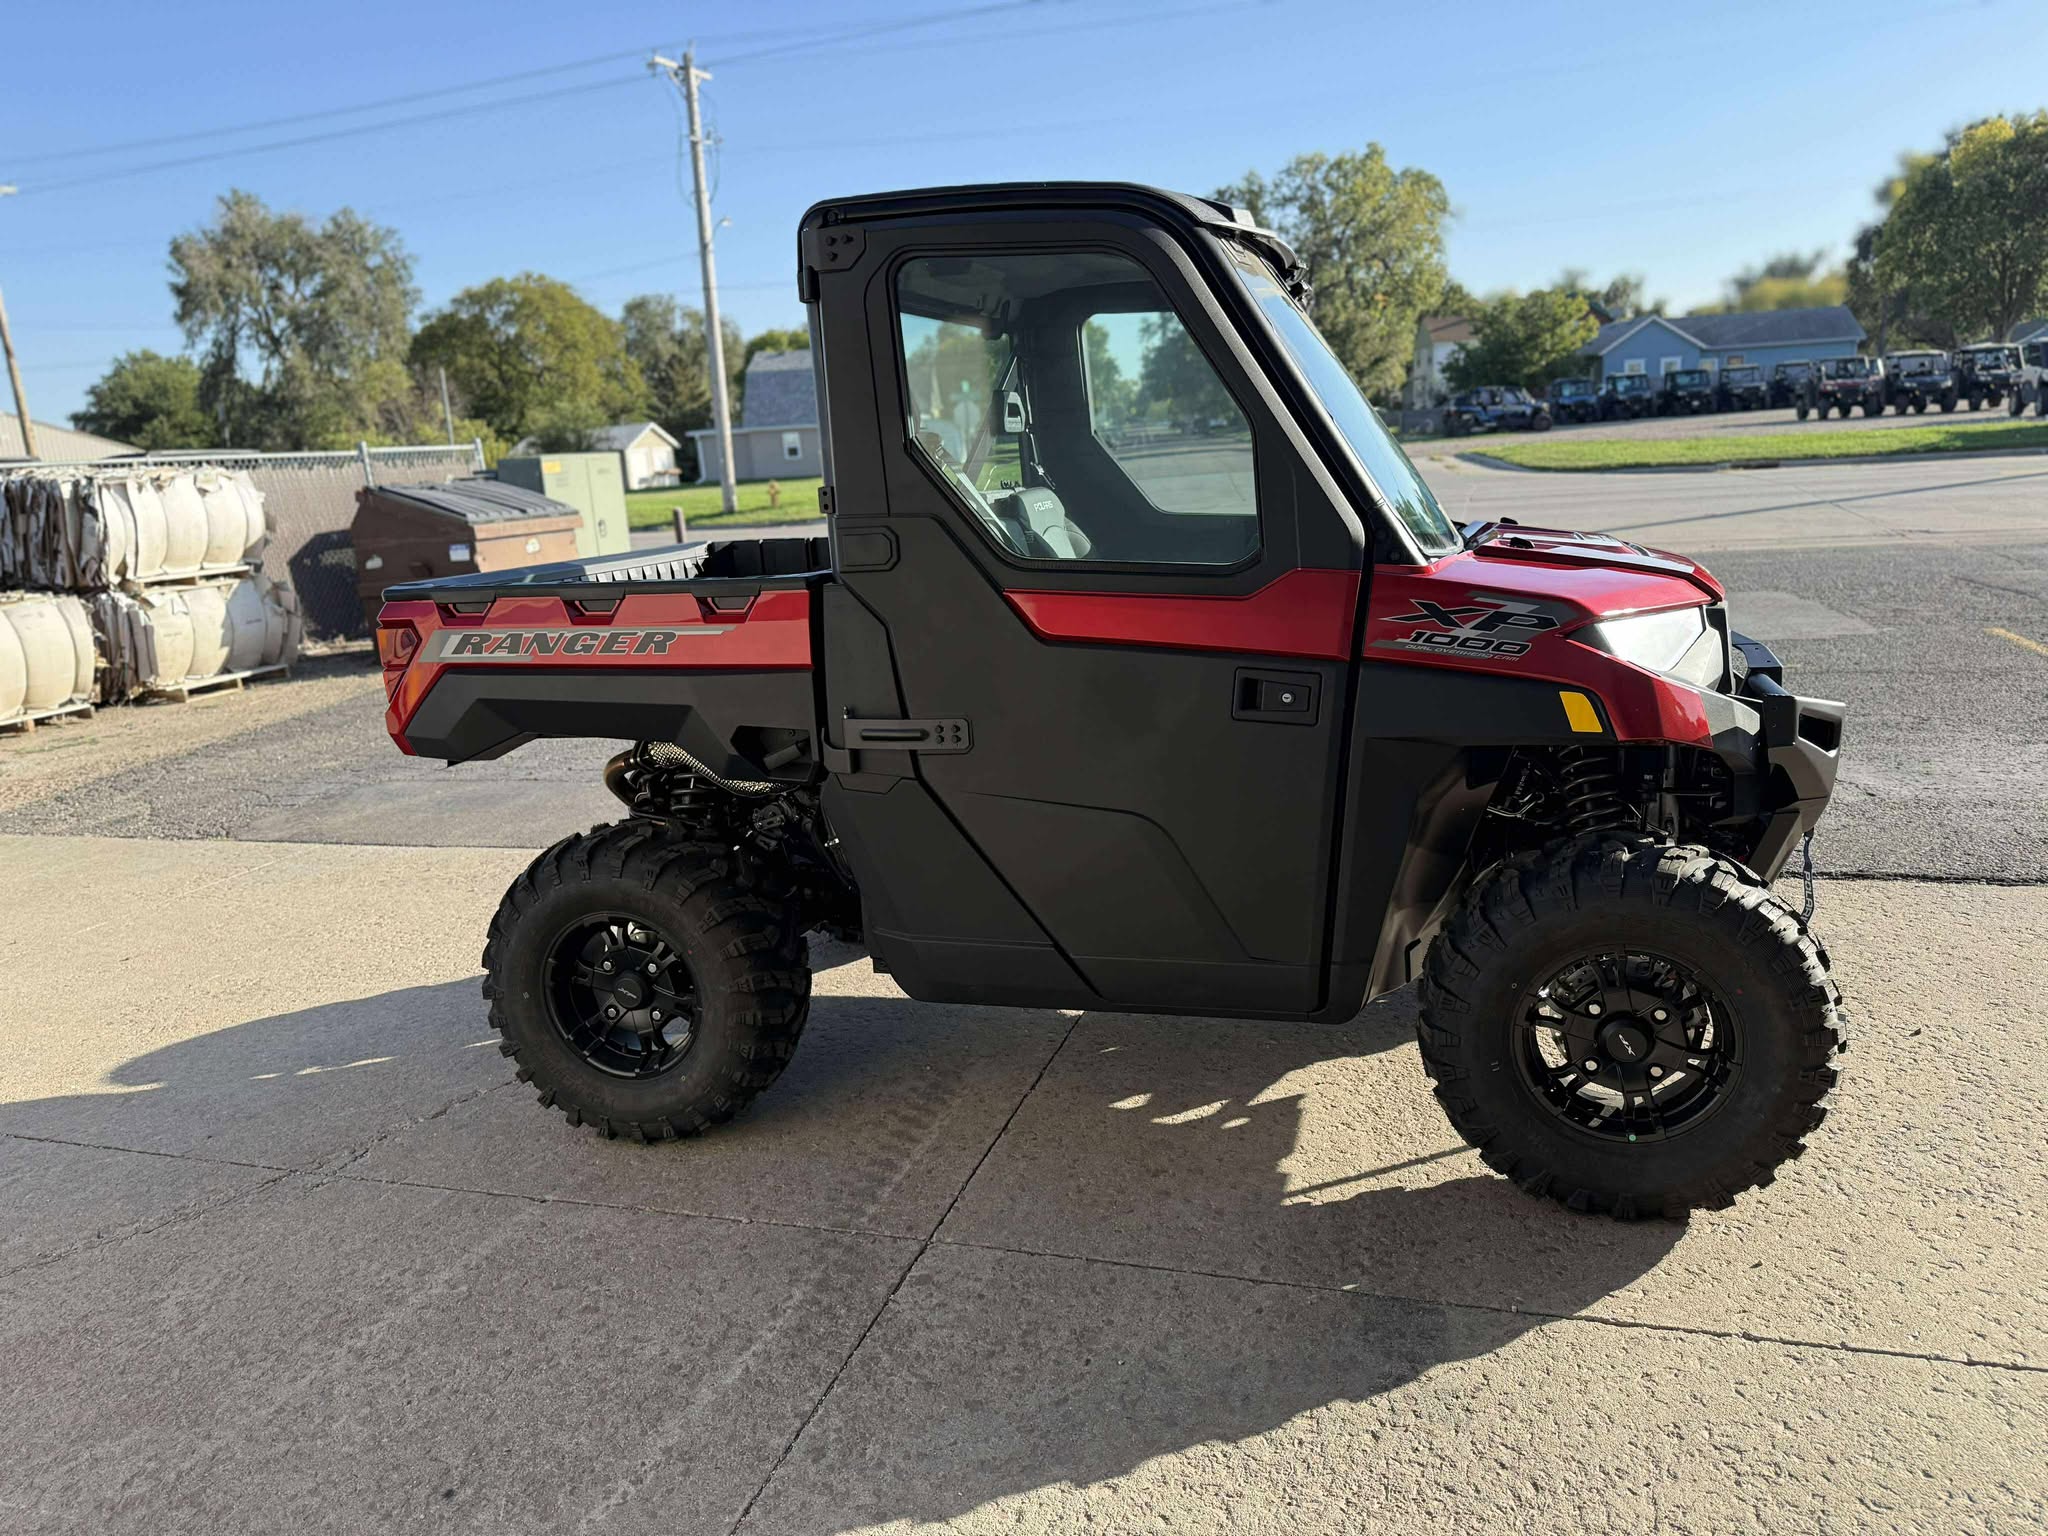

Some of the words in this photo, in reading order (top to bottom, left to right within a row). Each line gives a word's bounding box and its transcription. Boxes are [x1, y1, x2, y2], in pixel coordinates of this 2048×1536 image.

[1379, 598, 1560, 632] XP
[450, 631, 677, 656] RANGER
[1405, 644, 1432, 652] DUAL
[1434, 647, 1493, 659] OVERHEAD
[1494, 654, 1520, 662] CAM
[1409, 630, 1532, 656] 1000
[1800, 870, 1814, 922] POLARI
